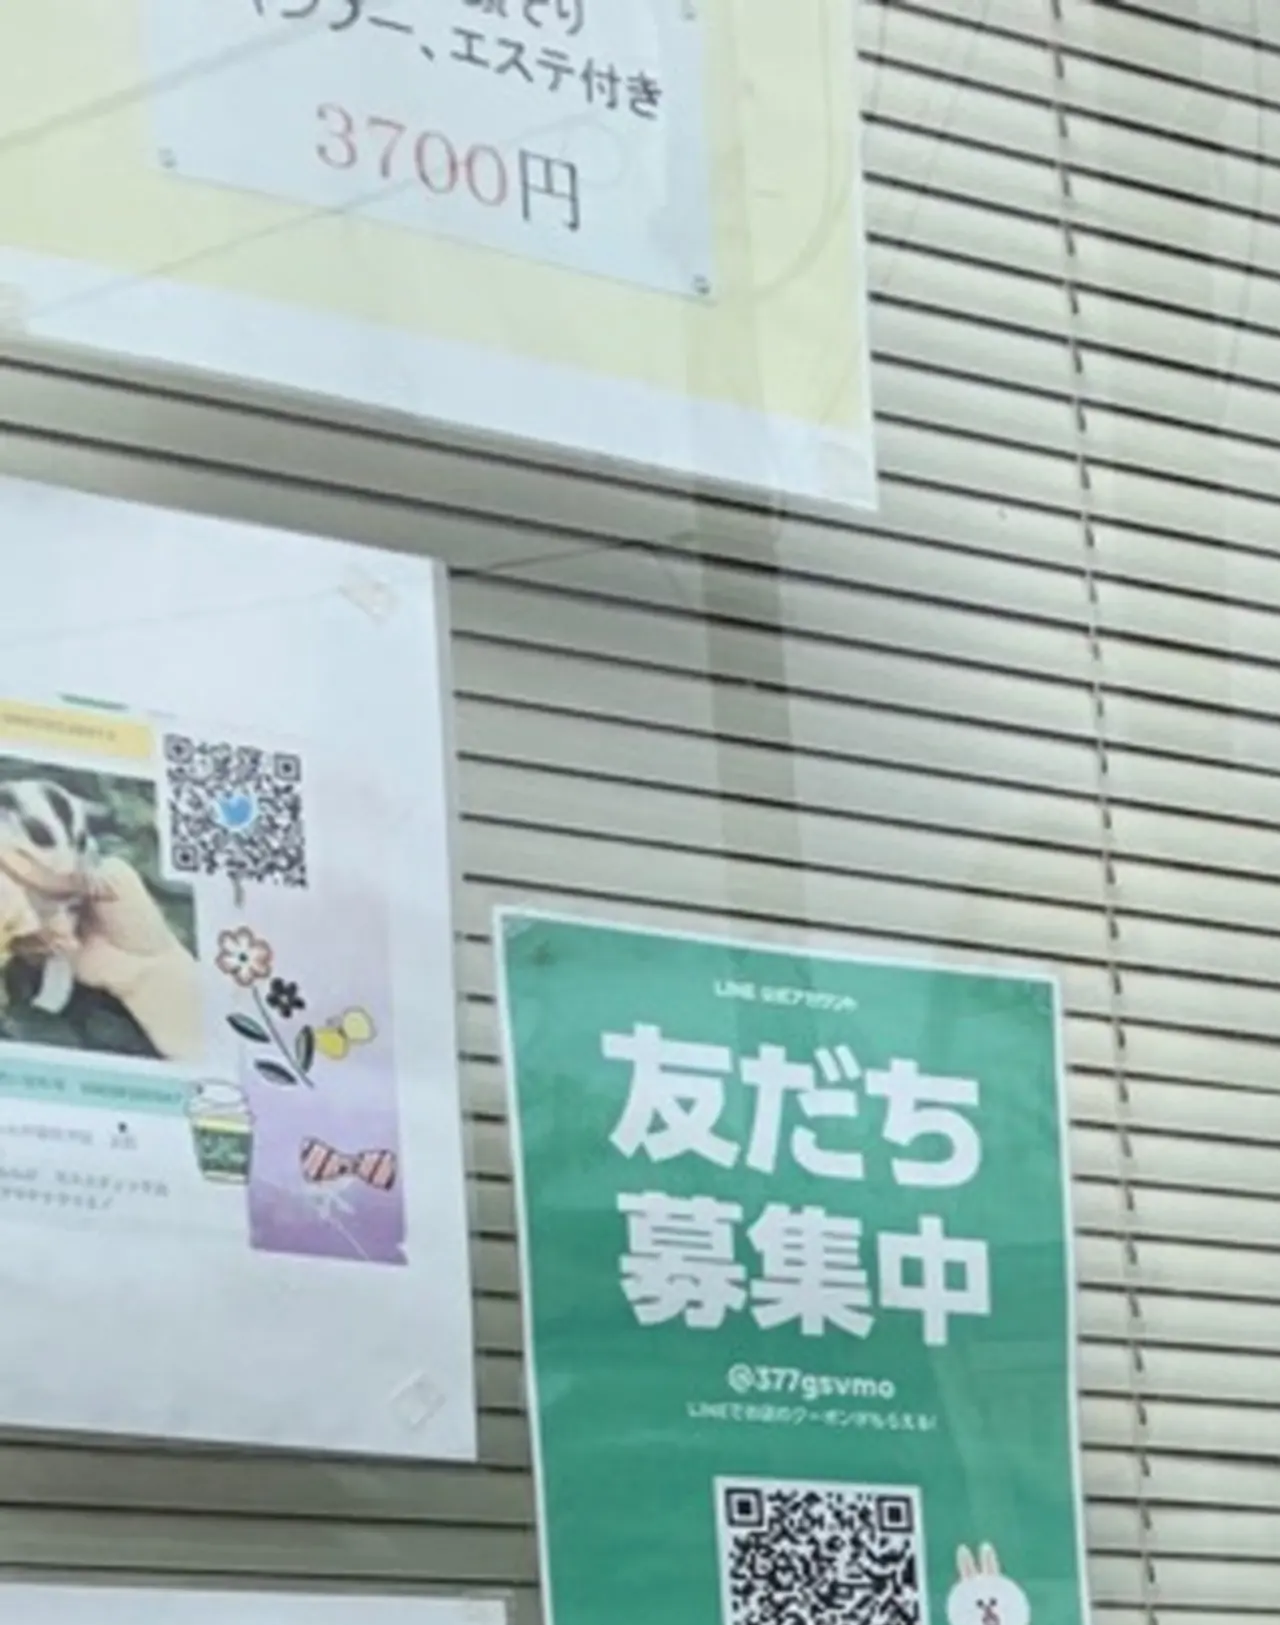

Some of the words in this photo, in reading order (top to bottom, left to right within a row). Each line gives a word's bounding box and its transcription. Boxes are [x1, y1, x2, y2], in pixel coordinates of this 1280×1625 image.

[316, 101, 581, 232] 3700円
[601, 1022, 982, 1189] 友だち
[616, 1190, 992, 1347] 募集中
